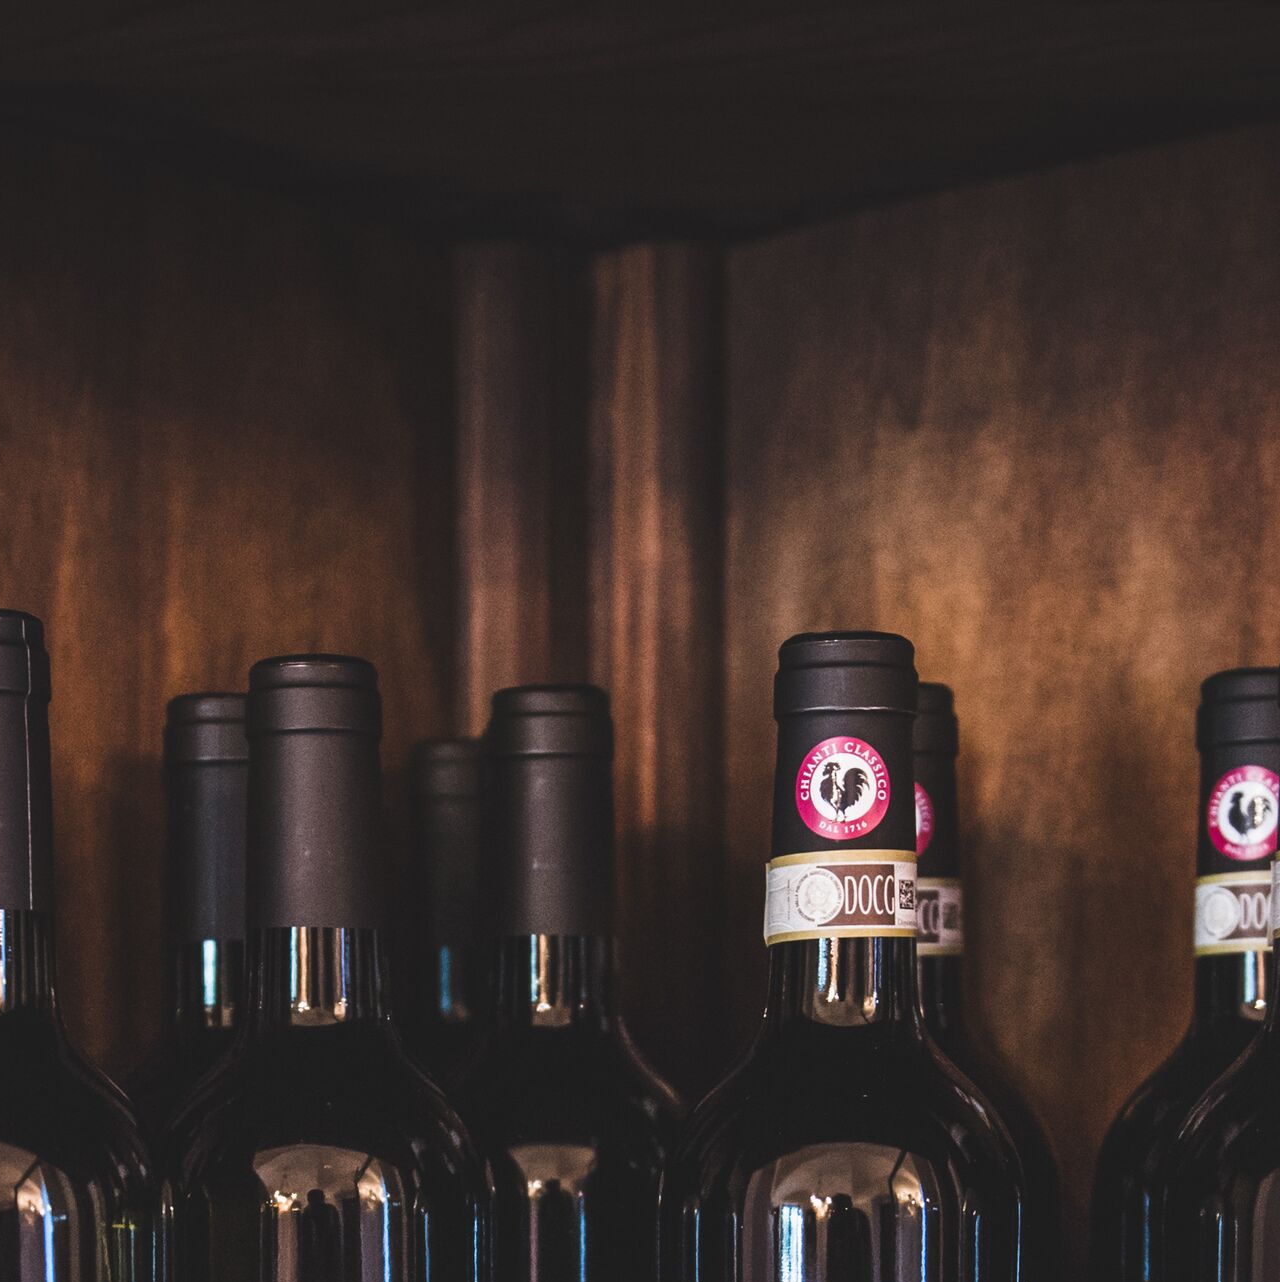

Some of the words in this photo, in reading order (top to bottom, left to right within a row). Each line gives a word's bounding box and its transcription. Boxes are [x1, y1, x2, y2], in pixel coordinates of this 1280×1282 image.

[800, 743, 838, 801] CHIANTI
[844, 741, 887, 801] CLASSICO
[818, 819, 839, 834] DAL
[844, 819, 868, 834] 1716
[844, 875, 895, 915] DOCG
